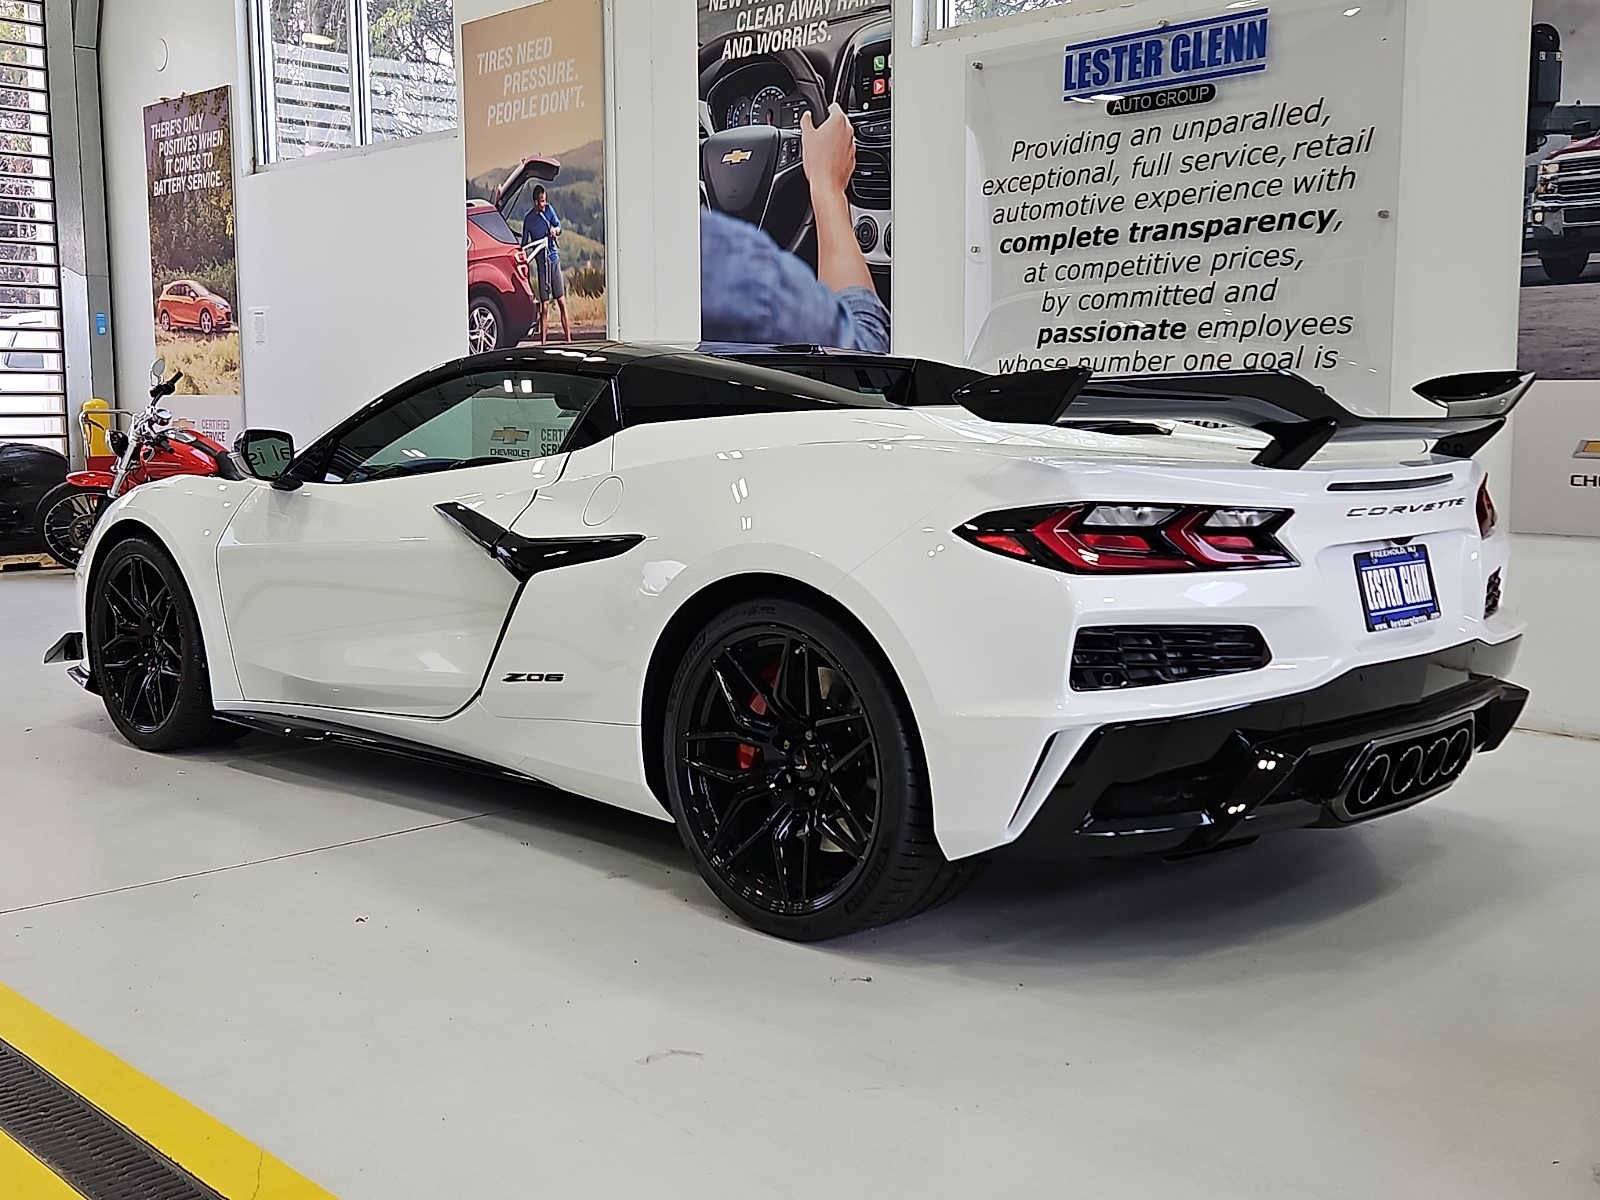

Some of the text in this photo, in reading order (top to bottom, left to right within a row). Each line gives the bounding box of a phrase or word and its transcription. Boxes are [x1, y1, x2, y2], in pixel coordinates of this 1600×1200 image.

[736, 2, 785, 33] CLEAR
[786, 0, 832, 22] AWAY
[477, 35, 552, 75] TIRES NEED
[721, 20, 832, 61] AND WORRIES.
[1064, 18, 1268, 92] LESTER GLENN
[503, 58, 578, 97] PRESSURE.
[487, 85, 585, 128] PEOPLE DON'T.
[1112, 86, 1210, 114] AUTO GROUP
[151, 113, 204, 140] THERE'S ONLY
[159, 129, 224, 157] POSITIVES WHEN
[1011, 97, 1331, 162] Providing an unparalled,
[165, 152, 214, 175] IT COMES TO
[982, 126, 1375, 196] exceptional, full service, retail
[153, 170, 223, 197] BATTERY SERVICE.
[993, 165, 1357, 224] automotive experience with
[999, 208, 1343, 255] complete transparency,
[1024, 246, 1304, 283] at competitive prices,
[1042, 277, 1279, 316] by committed and
[1037, 313, 1354, 349] passionate employees
[999, 345, 1338, 374] whose number one goal is
[201, 419, 230, 430] CERTIFIED
[490, 448, 530, 458] CHEVROLET
[1346, 497, 1466, 517] CORVETTE
[1361, 563, 1433, 611] LESTER GLENN
[501, 673, 564, 682] Z06
